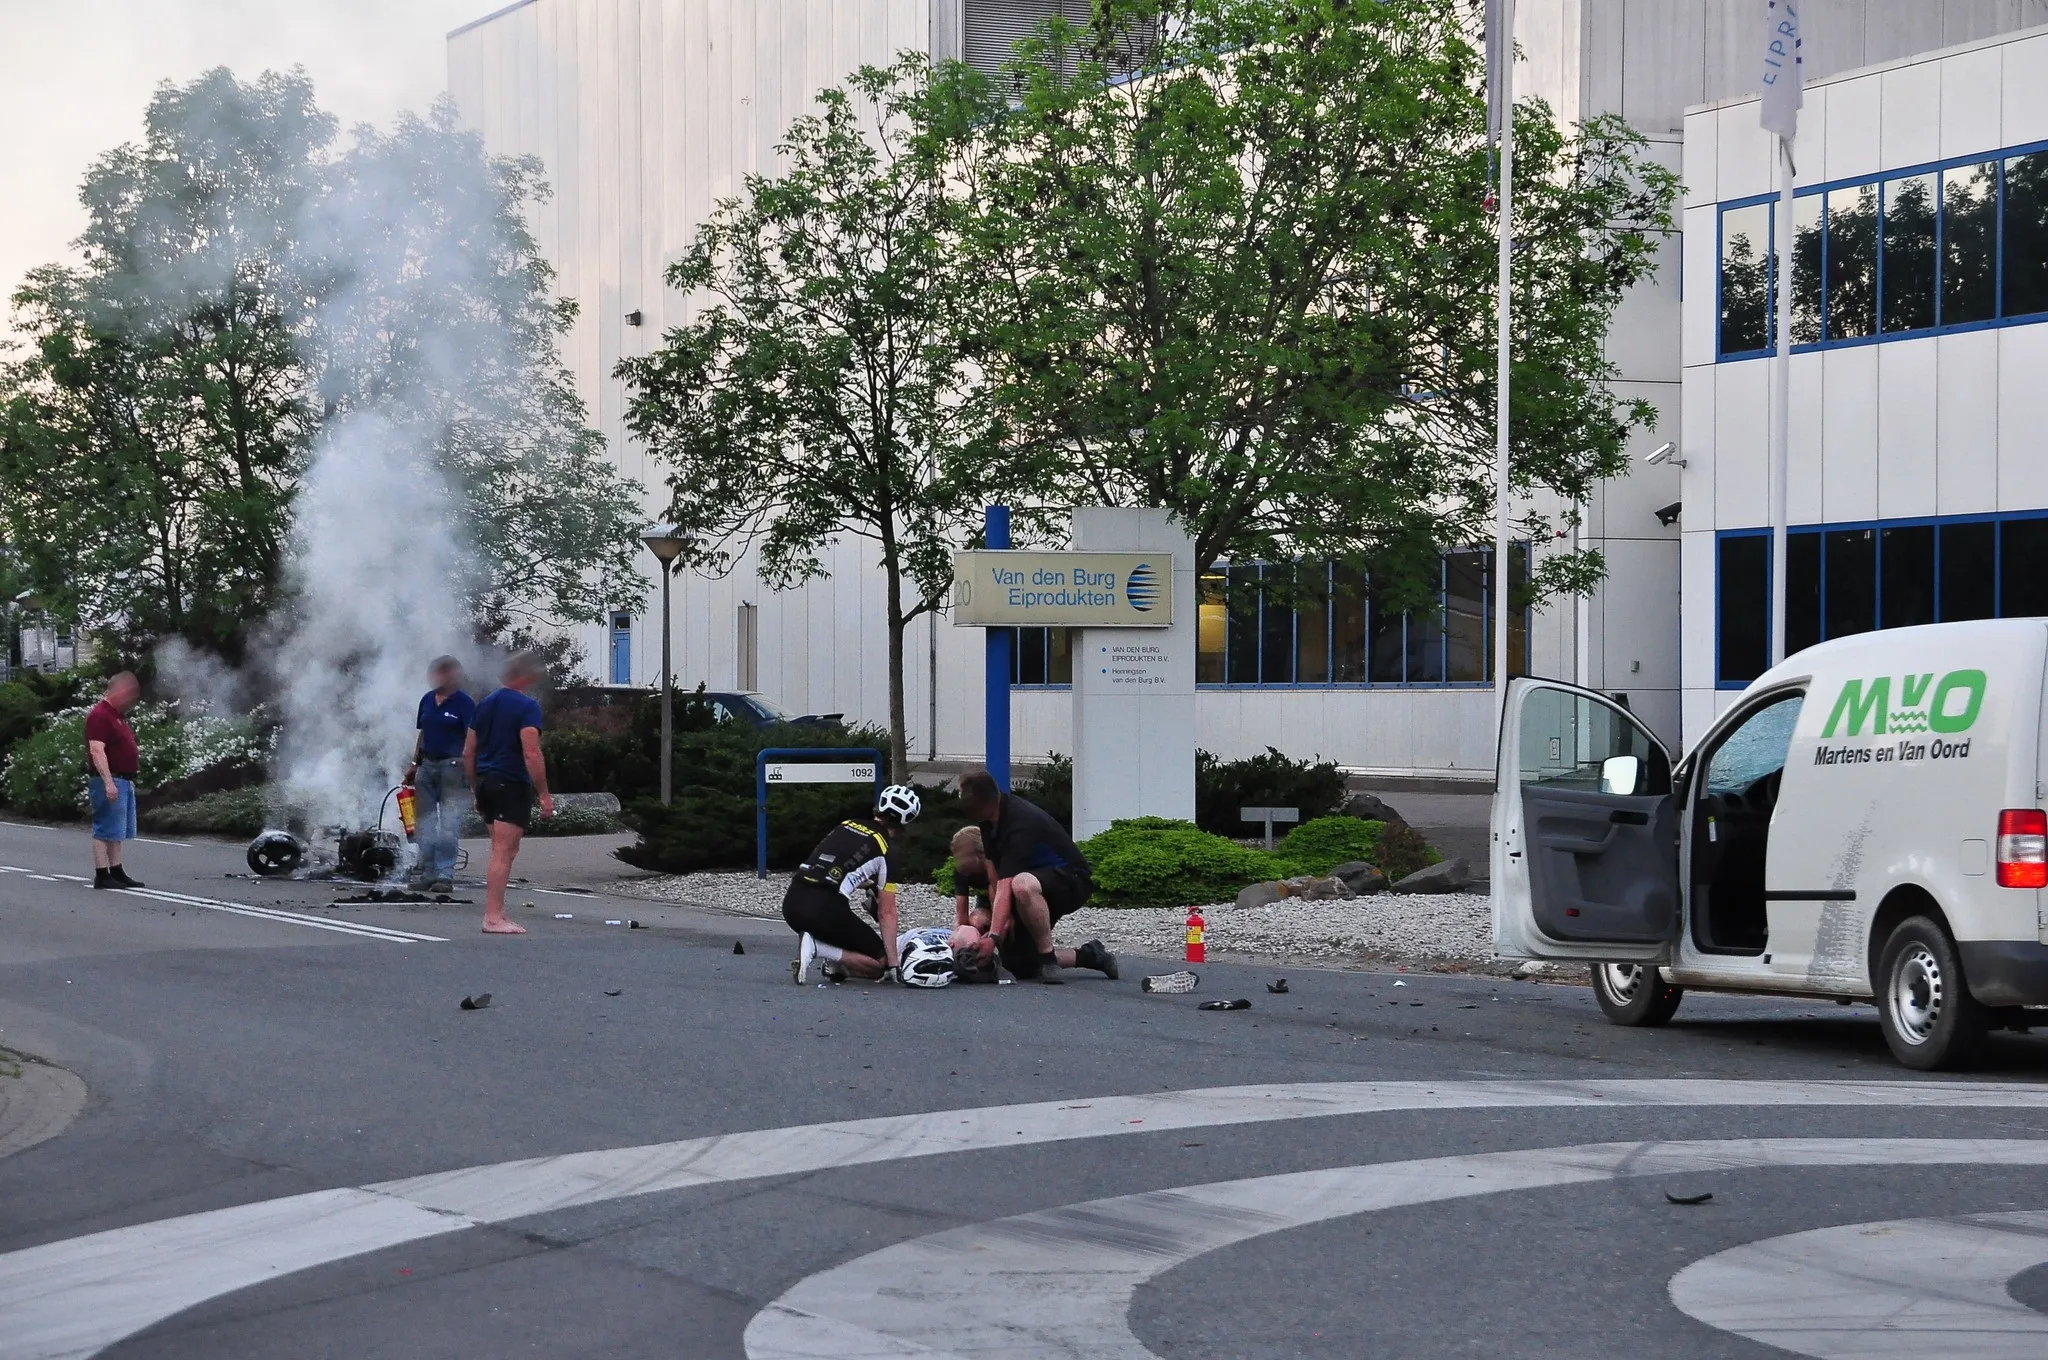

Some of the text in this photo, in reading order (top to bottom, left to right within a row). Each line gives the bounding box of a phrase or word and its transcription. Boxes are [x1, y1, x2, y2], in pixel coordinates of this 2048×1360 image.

[992, 567, 1116, 589] Van den Burg
[1008, 588, 1115, 608] Eiprodukten
[1814, 737, 1971, 765] Martens en Van Oord
[851, 768, 873, 777] 1092
